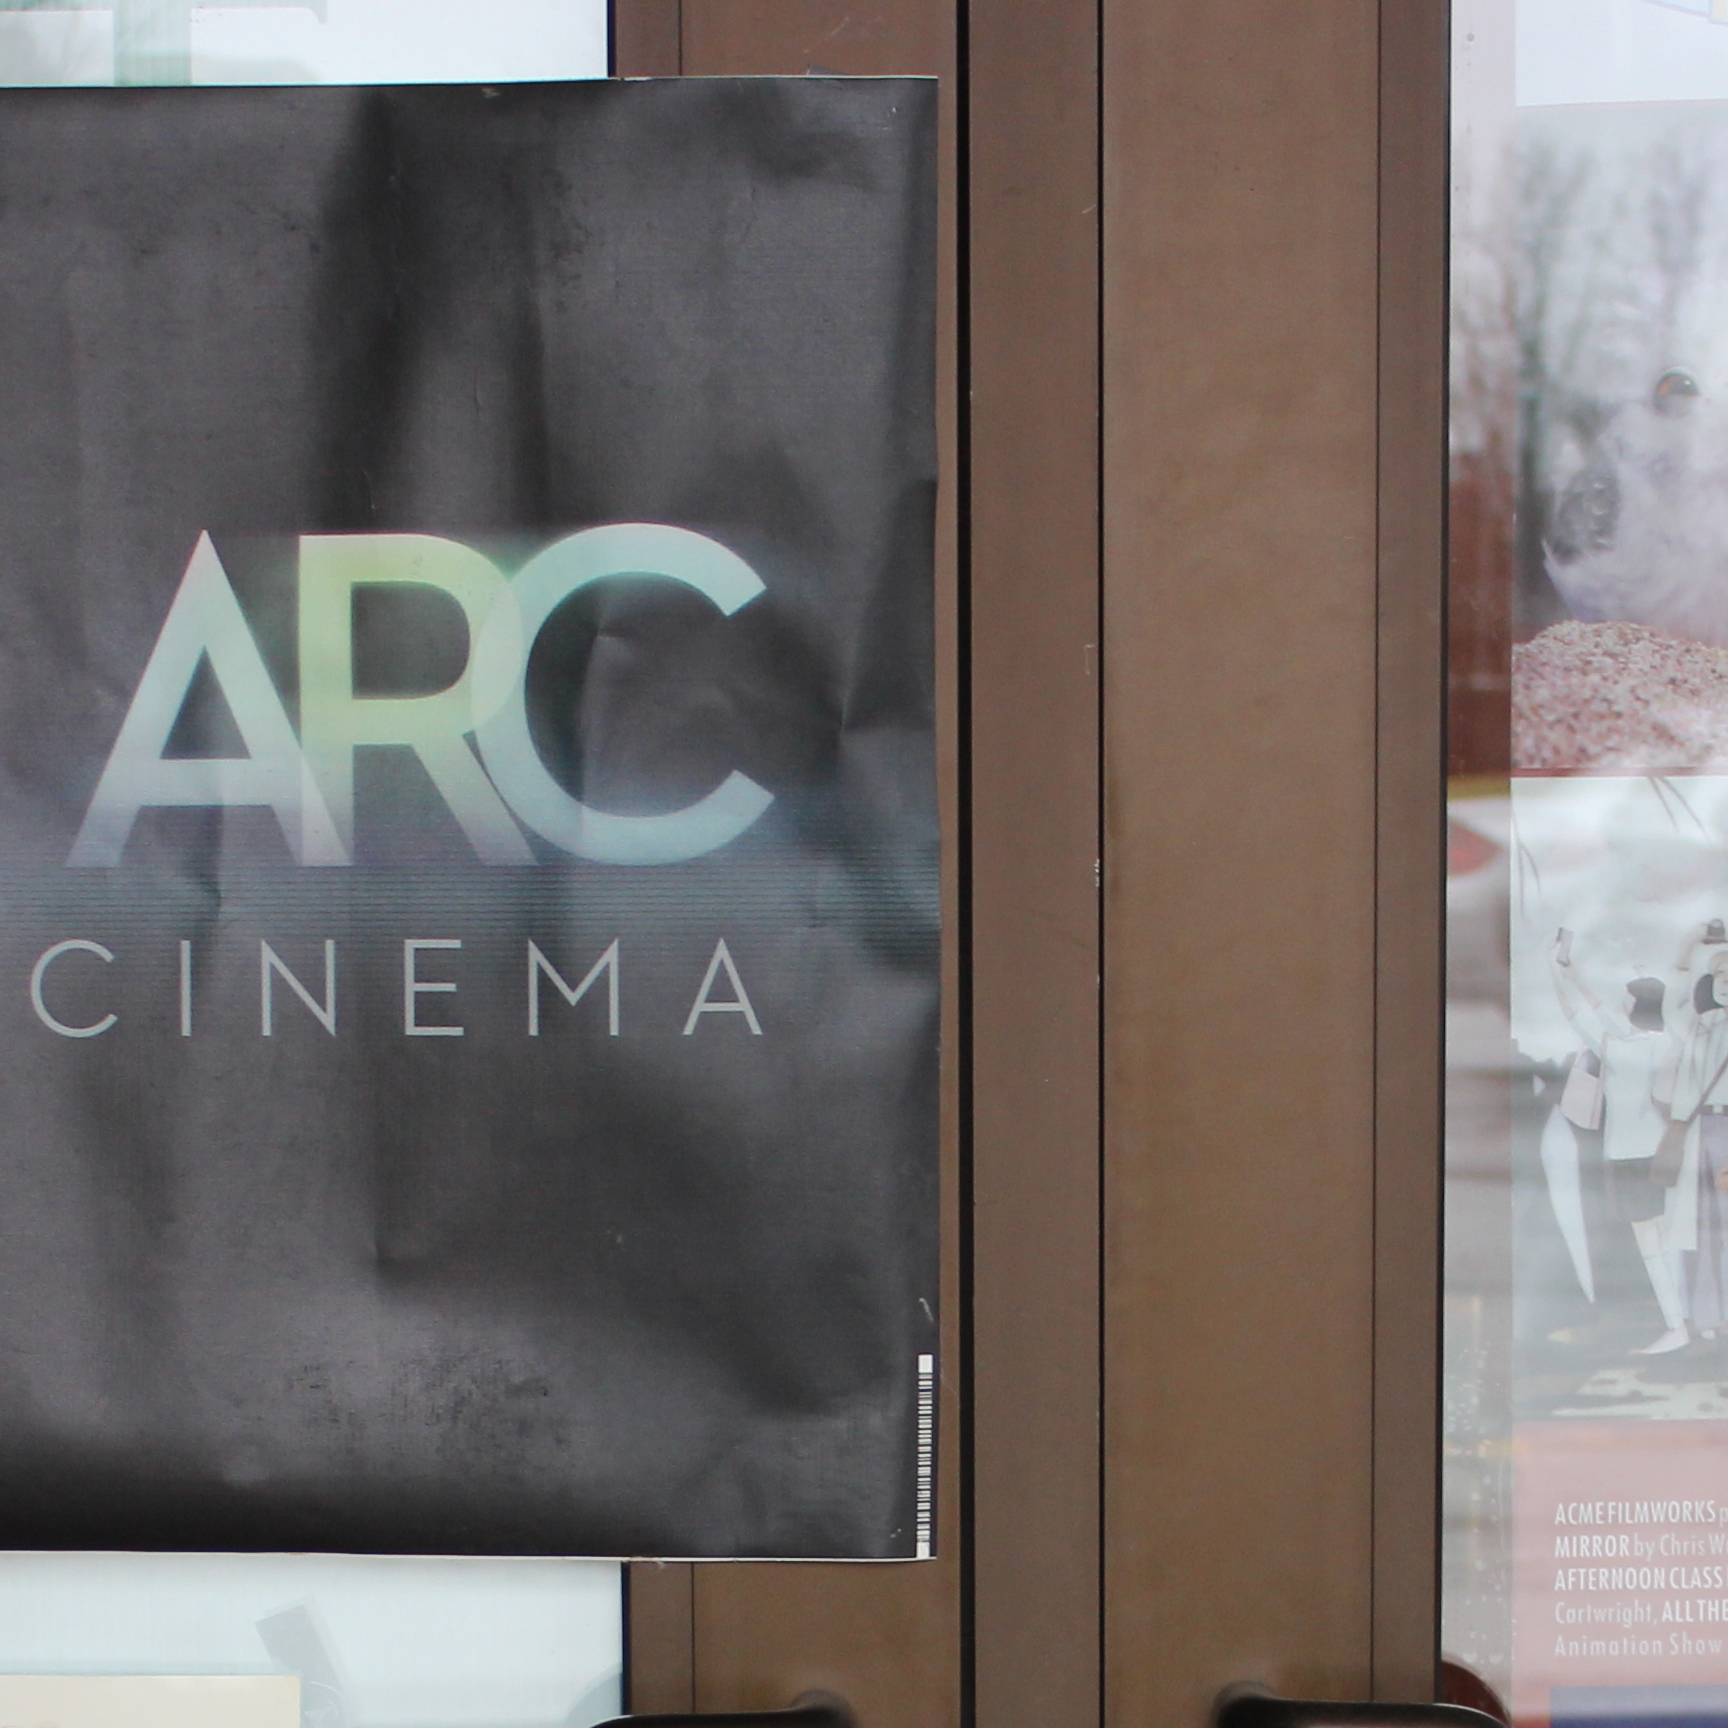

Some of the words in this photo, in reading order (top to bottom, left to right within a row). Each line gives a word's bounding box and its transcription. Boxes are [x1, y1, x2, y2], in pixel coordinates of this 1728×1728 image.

[65, 522, 776, 870] ARC
[29, 938, 765, 1039] CINEMA
[1554, 1502, 1604, 1524] ACME
[1608, 1500, 1716, 1524] FILMWORKS
[1554, 1535, 1630, 1558] MIRROR
[1554, 1568, 1666, 1590] AFTERNOON
[1670, 1566, 1722, 1589] CLASS
[1662, 1600, 1694, 1622] ALL
